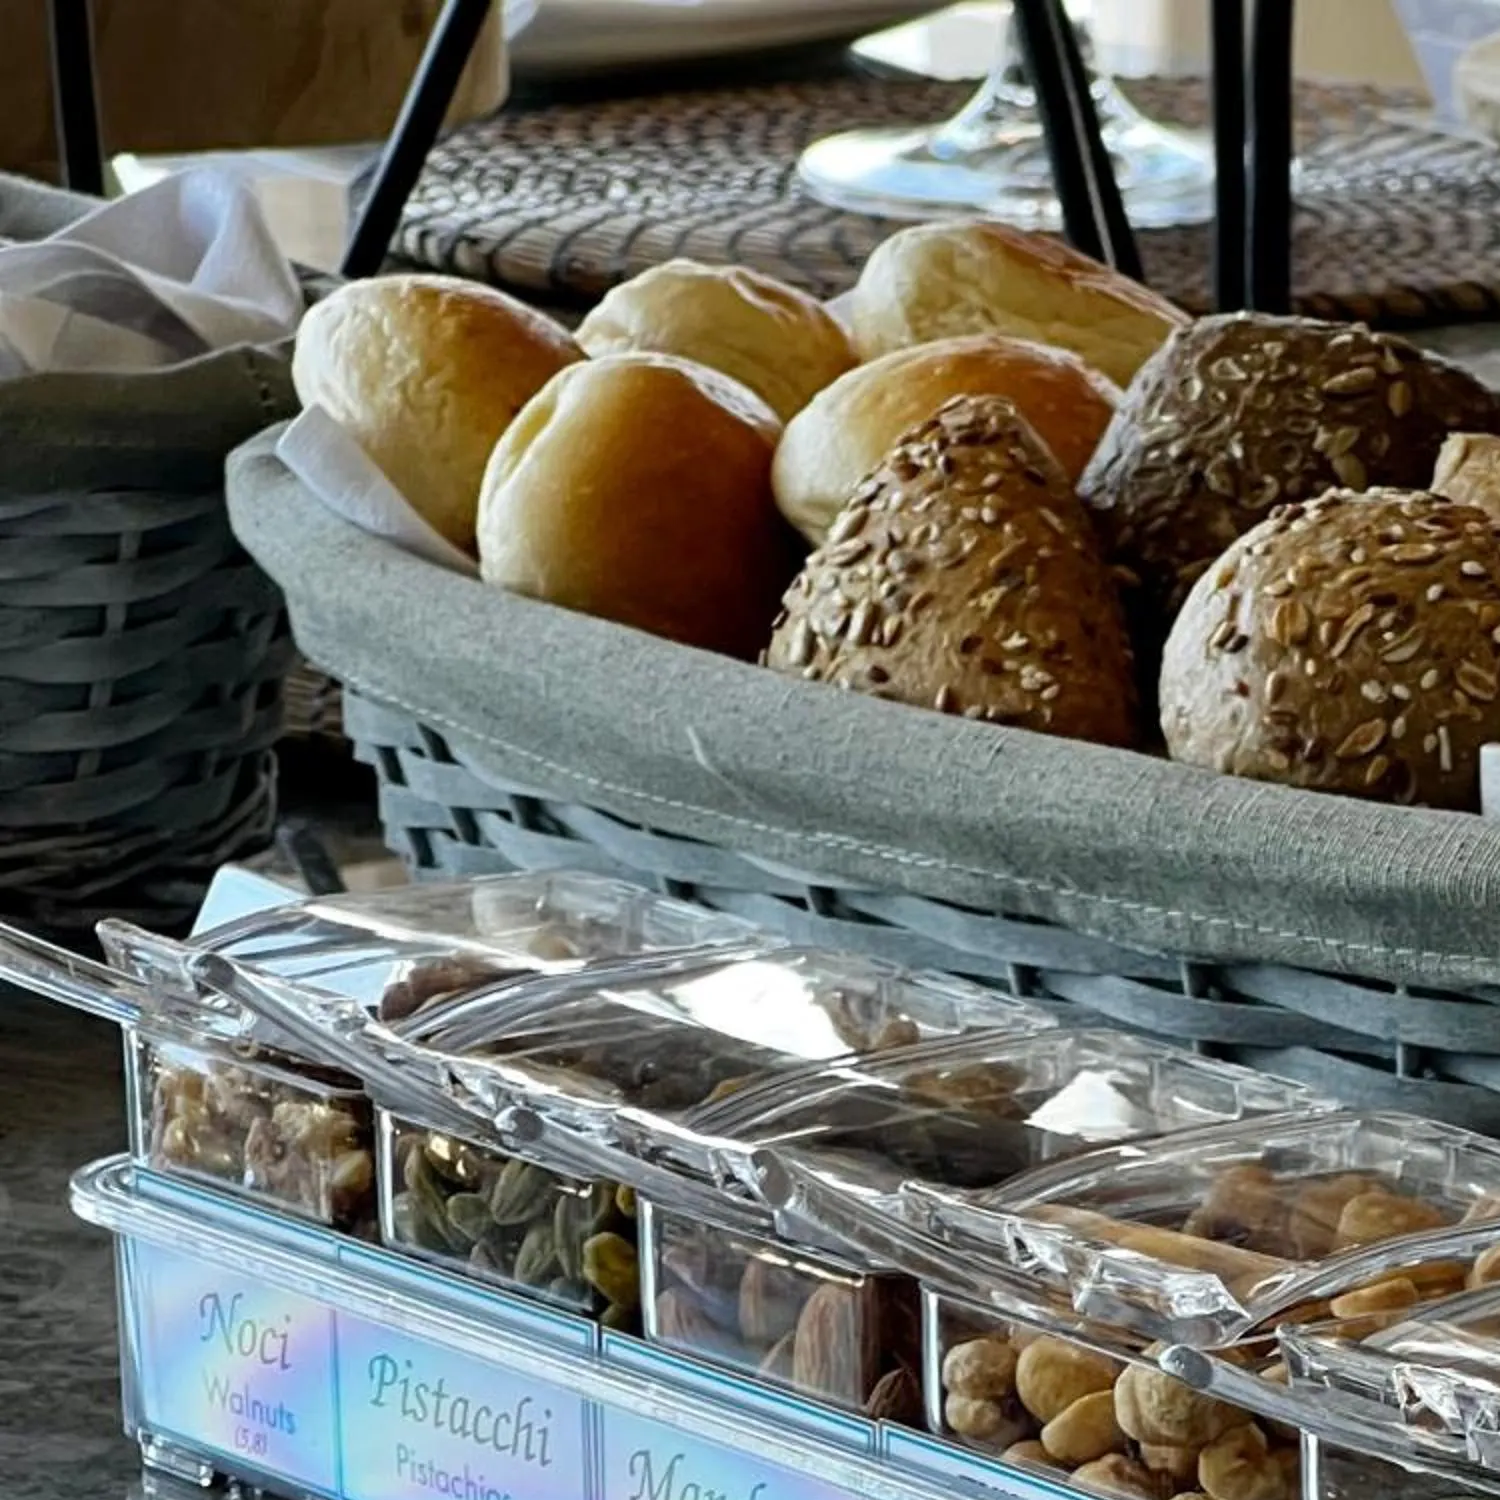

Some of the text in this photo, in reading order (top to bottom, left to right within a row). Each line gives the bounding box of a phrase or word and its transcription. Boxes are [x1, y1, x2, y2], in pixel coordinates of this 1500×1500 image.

[200, 1291, 293, 1371] Noci
[203, 1374, 296, 1436] Walnuts
[368, 1353, 553, 1467] Pistacchi
